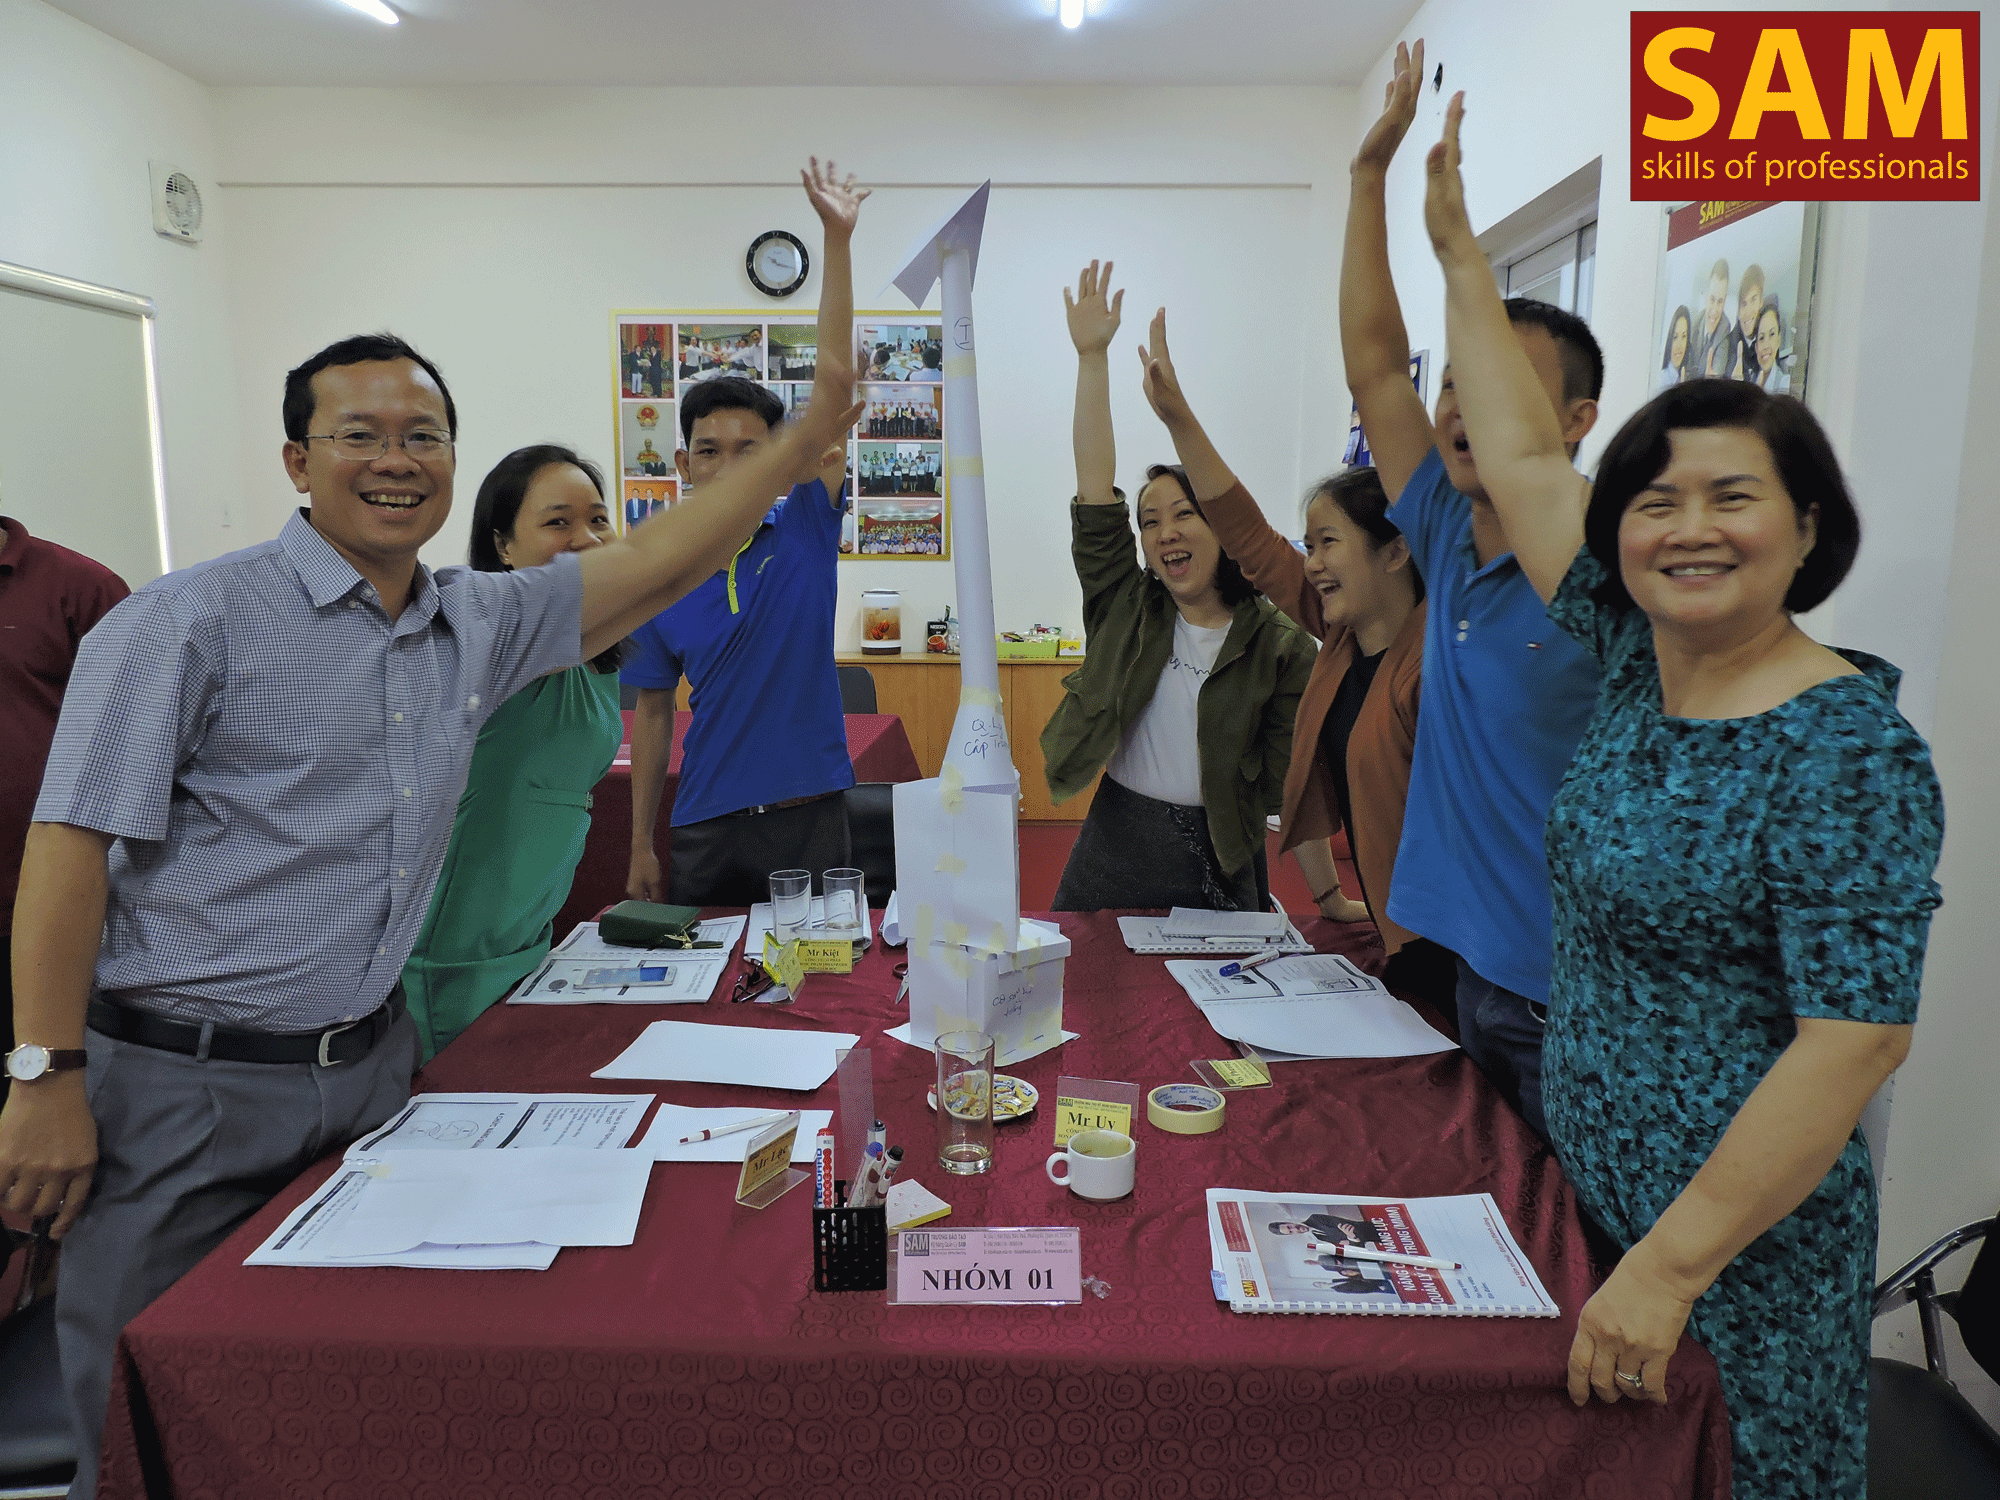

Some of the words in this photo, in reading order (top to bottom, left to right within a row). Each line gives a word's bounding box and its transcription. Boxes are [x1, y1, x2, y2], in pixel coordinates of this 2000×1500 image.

[1699, 201, 1725, 225] SAM
[806, 949, 820, 957] Mr
[1067, 1111, 1091, 1127] Mr
[753, 1157, 769, 1171] Mr
[905, 1234, 928, 1251] SAM
[1396, 1230, 1419, 1255] TRUNG
[922, 1262, 1012, 1291] NHÓM
[1028, 1268, 1054, 1291] 01
[1242, 1280, 1256, 1297] SAM
